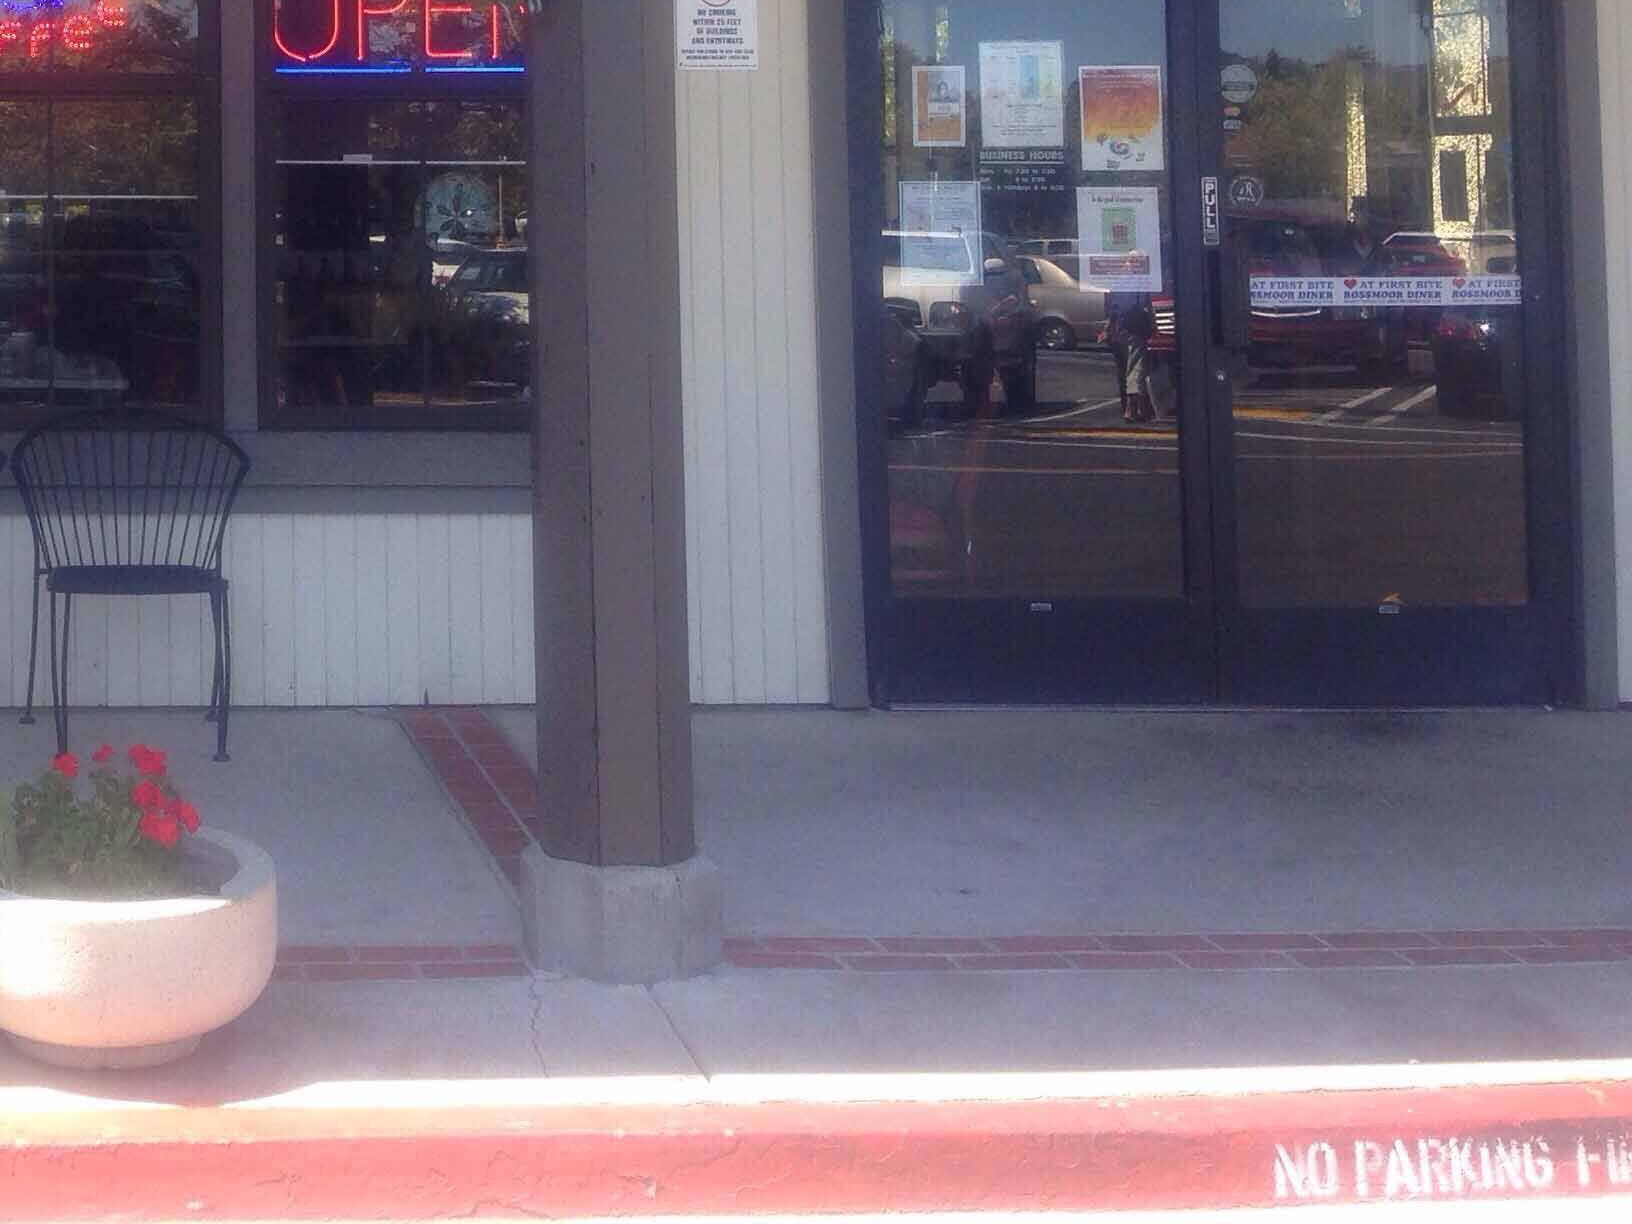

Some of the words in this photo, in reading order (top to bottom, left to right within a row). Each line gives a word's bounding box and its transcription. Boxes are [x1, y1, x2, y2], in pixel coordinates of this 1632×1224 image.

[697, 8, 706, 17] NO
[708, 8, 736, 17] SMOKING
[979, 151, 1025, 160] BUSINESS
[1029, 151, 1065, 160] HOURS
[1204, 182, 1216, 229] PULL
[1251, 281, 1266, 290] AT
[1269, 281, 1304, 290] FIRST
[1307, 281, 1335, 290] BITE
[1359, 280, 1373, 289] AT
[1378, 280, 1412, 289] FIRST
[1416, 280, 1443, 289] BITE
[1468, 279, 1481, 288] AT
[1297, 291, 1333, 299] DINER
[1344, 290, 1404, 299] ROSSMOOR
[1407, 290, 1441, 299] DINER
[1452, 289, 1511, 299] ROSSMOOR
[1273, 1141, 1339, 1199] NO
[1353, 1136, 1554, 1199] PARKING
